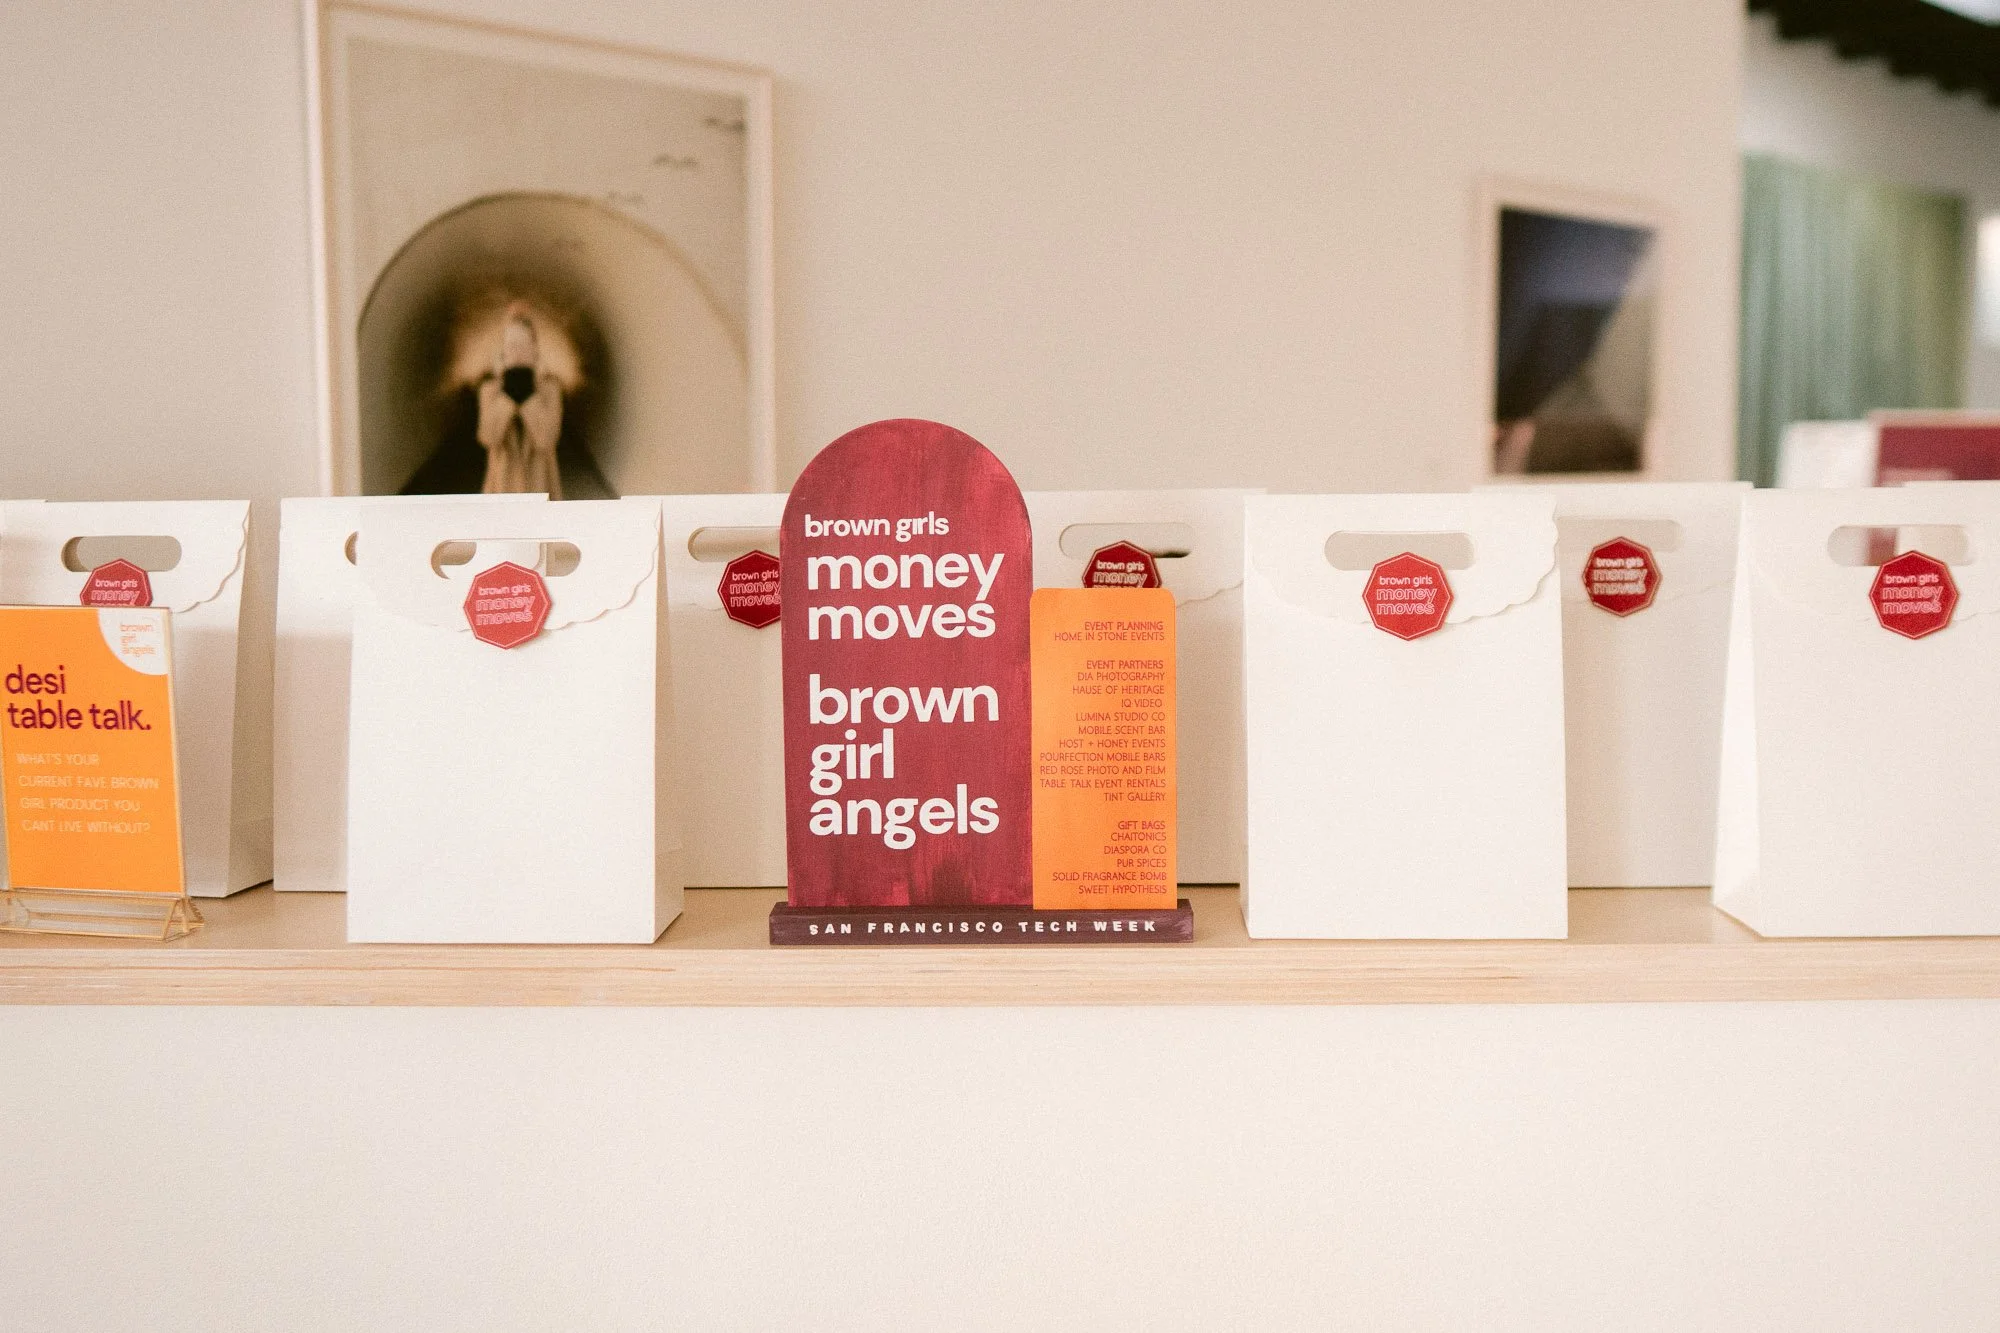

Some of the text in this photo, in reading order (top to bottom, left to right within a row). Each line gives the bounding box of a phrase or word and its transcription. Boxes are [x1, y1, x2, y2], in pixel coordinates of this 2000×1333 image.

[805, 511, 949, 542] brown girls
[1096, 560, 1145, 572] brown girls
[732, 569, 779, 581] brown girls
[807, 553, 1005, 601] money
[1093, 571, 1148, 588] money
[1379, 575, 1433, 587] brown girls
[1885, 573, 1940, 585] brown girls
[95, 578, 121, 588] brown
[729, 581, 781, 596] money
[478, 584, 532, 596] brown girls
[1376, 588, 1438, 604] money
[1882, 586, 1944, 603] money
[91, 589, 140, 606] money
[475, 595, 536, 612] money
[1376, 602, 1436, 615] moves
[1882, 601, 1942, 614] moves
[475, 611, 534, 626] moves
[808, 602, 996, 640] moves
[1084, 621, 1164, 631] EVENT PLANNING
[1054, 632, 1165, 641] HOME IN STONE EVENTS
[1086, 660, 1164, 669] EVENT PARTNERS
[5, 664, 66, 694] desi
[1077, 672, 1165, 681] DIA PHOTOGRAPHY
[1072, 685, 1165, 695] HAUSE OF HERITAGE
[809, 673, 1000, 724] brown
[1134, 698, 1163, 708] VIDEO
[7, 699, 152, 730] table talk.
[1075, 712, 1166, 722] LUMINA STUDIO CO
[1078, 725, 1166, 735] MOBILE SCENT BAR
[1059, 739, 1085, 748] HOST
[1097, 739, 1129, 748] HONEY
[1131, 739, 1166, 748] EVENTS
[66, 753, 100, 766] YOUR
[809, 728, 894, 796] girl
[1040, 752, 1166, 762] POURFECTION MOBILE BARS
[1040, 765, 1166, 775] RED ROSE PHOTO AND FILM
[19, 775, 161, 789] CURRENT FAVE BROWN
[1040, 779, 1167, 788] TABLE TALK EVENT RENTALS
[1104, 792, 1166, 801] TINT GALLERY
[50, 798, 110, 811] PRODUCT
[112, 799, 142, 812] YOU
[809, 783, 1001, 850] angels
[1117, 820, 1166, 830] GIFT BAGS
[1110, 832, 1167, 841] CHAITONICS
[1104, 845, 1167, 855] DIASPORA CO
[1116, 858, 1167, 868] PUR SPICES
[1052, 872, 1167, 881] SOLID FRAGRANCE BOMB
[1078, 885, 1167, 894] SWEET HYPOTHESIS
[809, 920, 1158, 936] SAN FRANCISCO TECH WEEK
